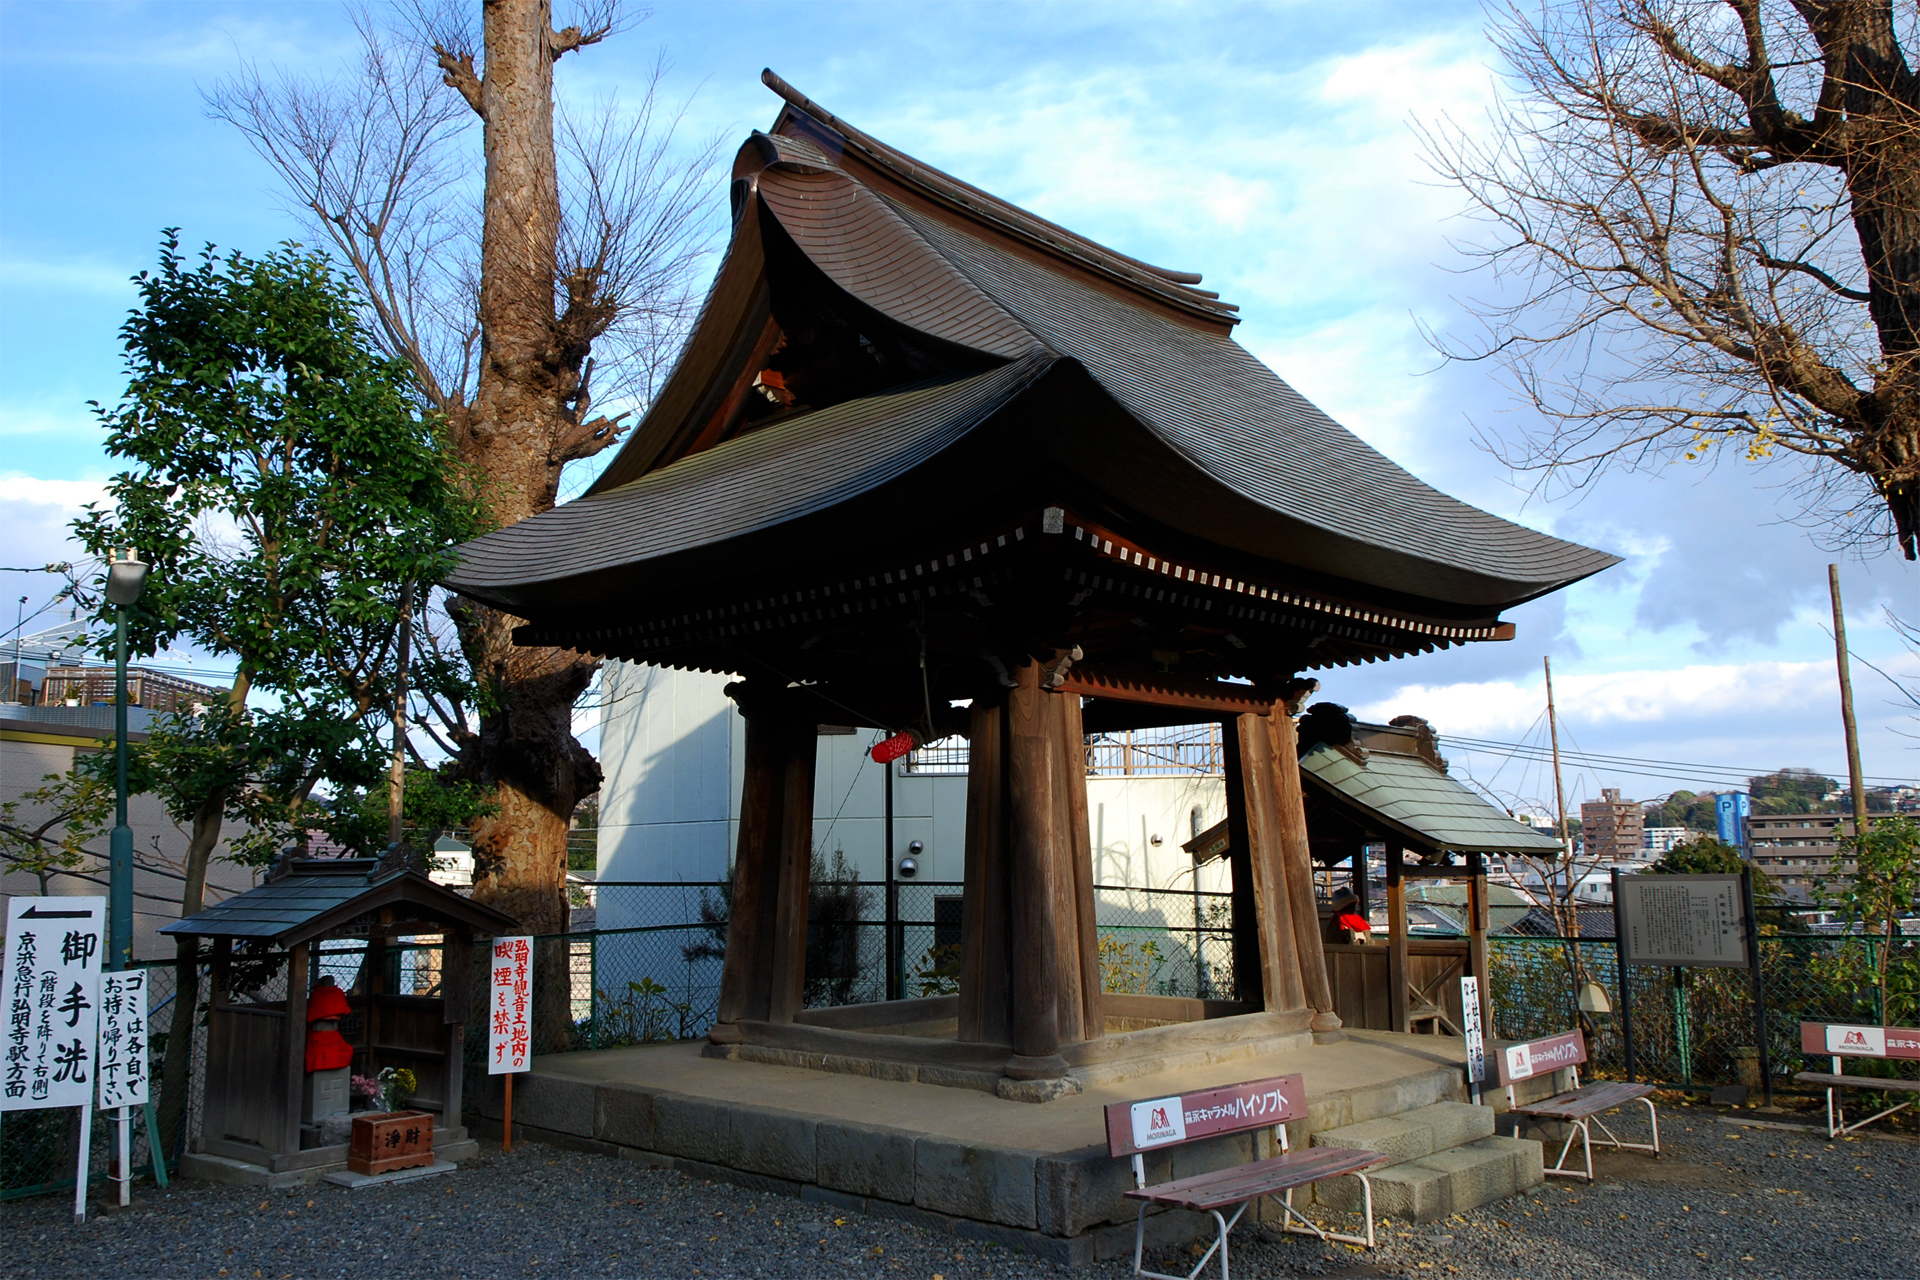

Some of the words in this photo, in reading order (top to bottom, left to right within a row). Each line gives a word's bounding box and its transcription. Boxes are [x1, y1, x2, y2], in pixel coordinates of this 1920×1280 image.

[1722, 801, 1732, 812] P
[5, 931, 37, 1098] 京浜急行弘明寺駅方面
[52, 930, 97, 1083] 御手洗
[102, 977, 123, 1105] お持ち帰り下さい
[126, 971, 146, 1096] ゴミは各自で
[493, 941, 514, 1064] 喫煙を禁ず
[510, 939, 530, 1068] 弘明寺観音土地内の
[1146, 1129, 1177, 1141] MORINAGA
